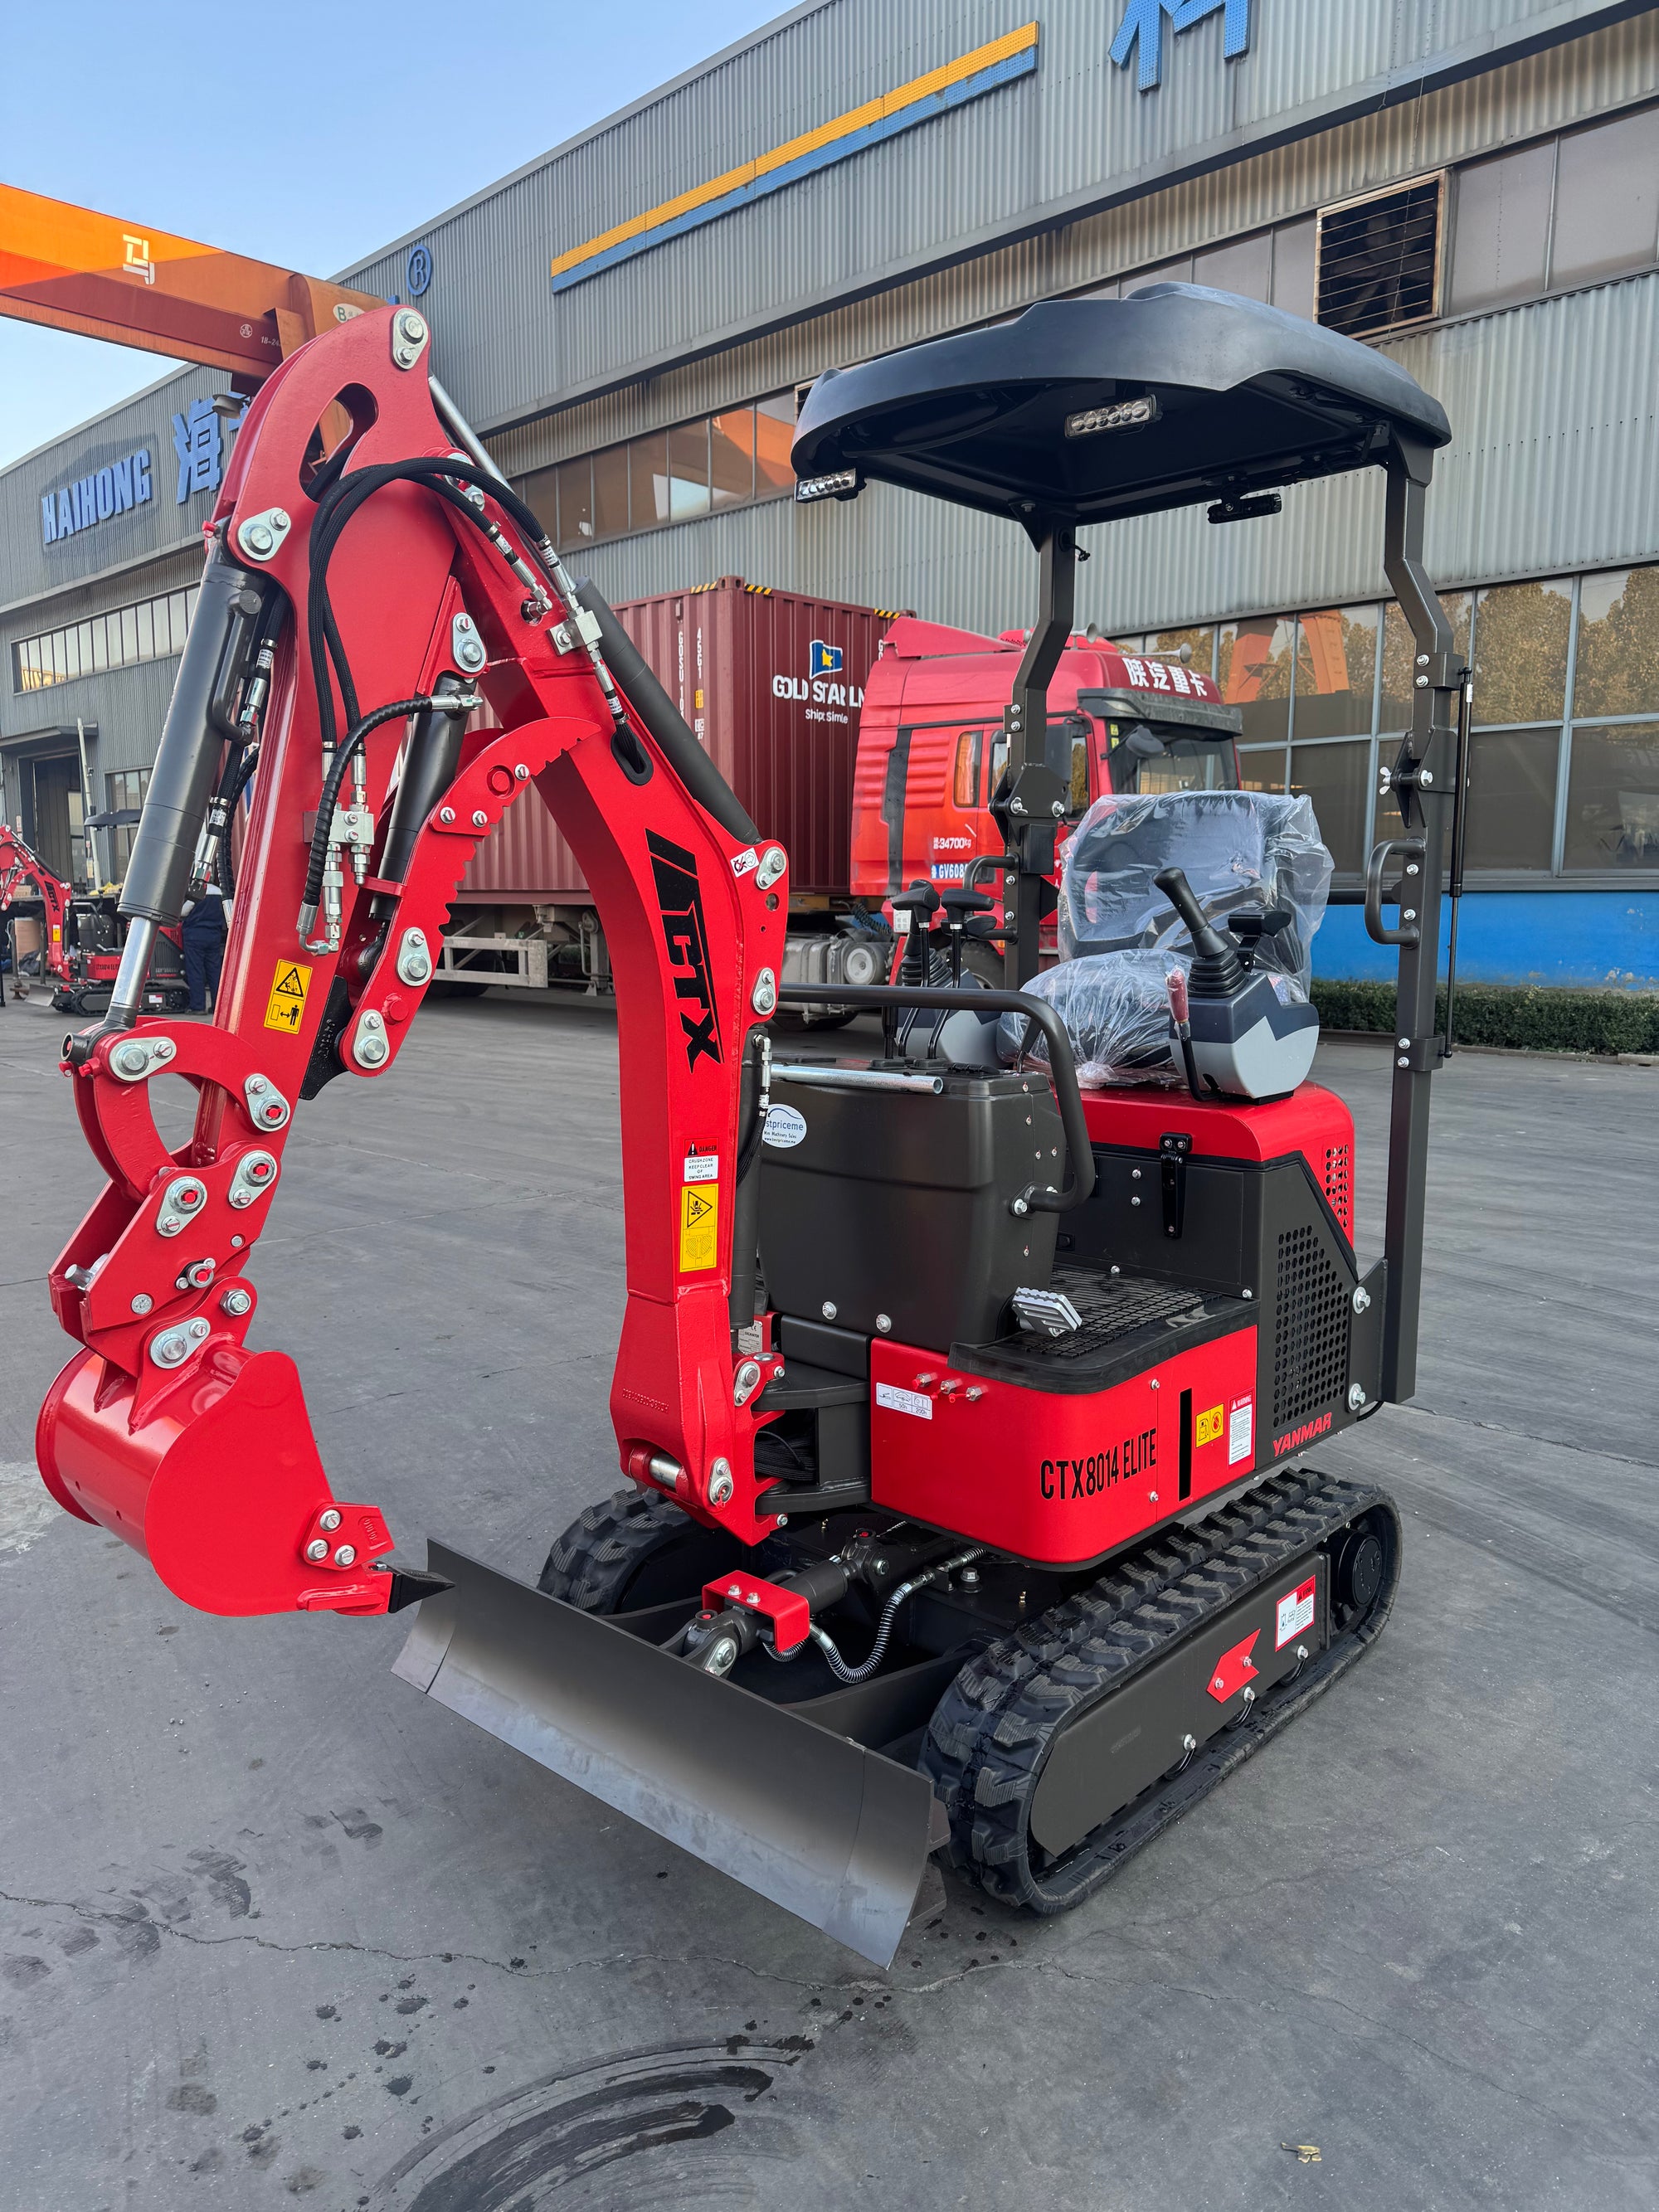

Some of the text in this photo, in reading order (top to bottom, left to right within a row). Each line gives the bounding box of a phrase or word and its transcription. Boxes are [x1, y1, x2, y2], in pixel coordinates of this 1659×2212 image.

[41, 449, 152, 545] HAIHONG
[772, 674, 809, 701] GOLD
[1121, 657, 1208, 697] 陕汽重卡
[766, 1120, 804, 1130] stpriceme
[1272, 1411, 1332, 1457] YANMAR
[1040, 1427, 1156, 1500] CTX8014 ELITE
